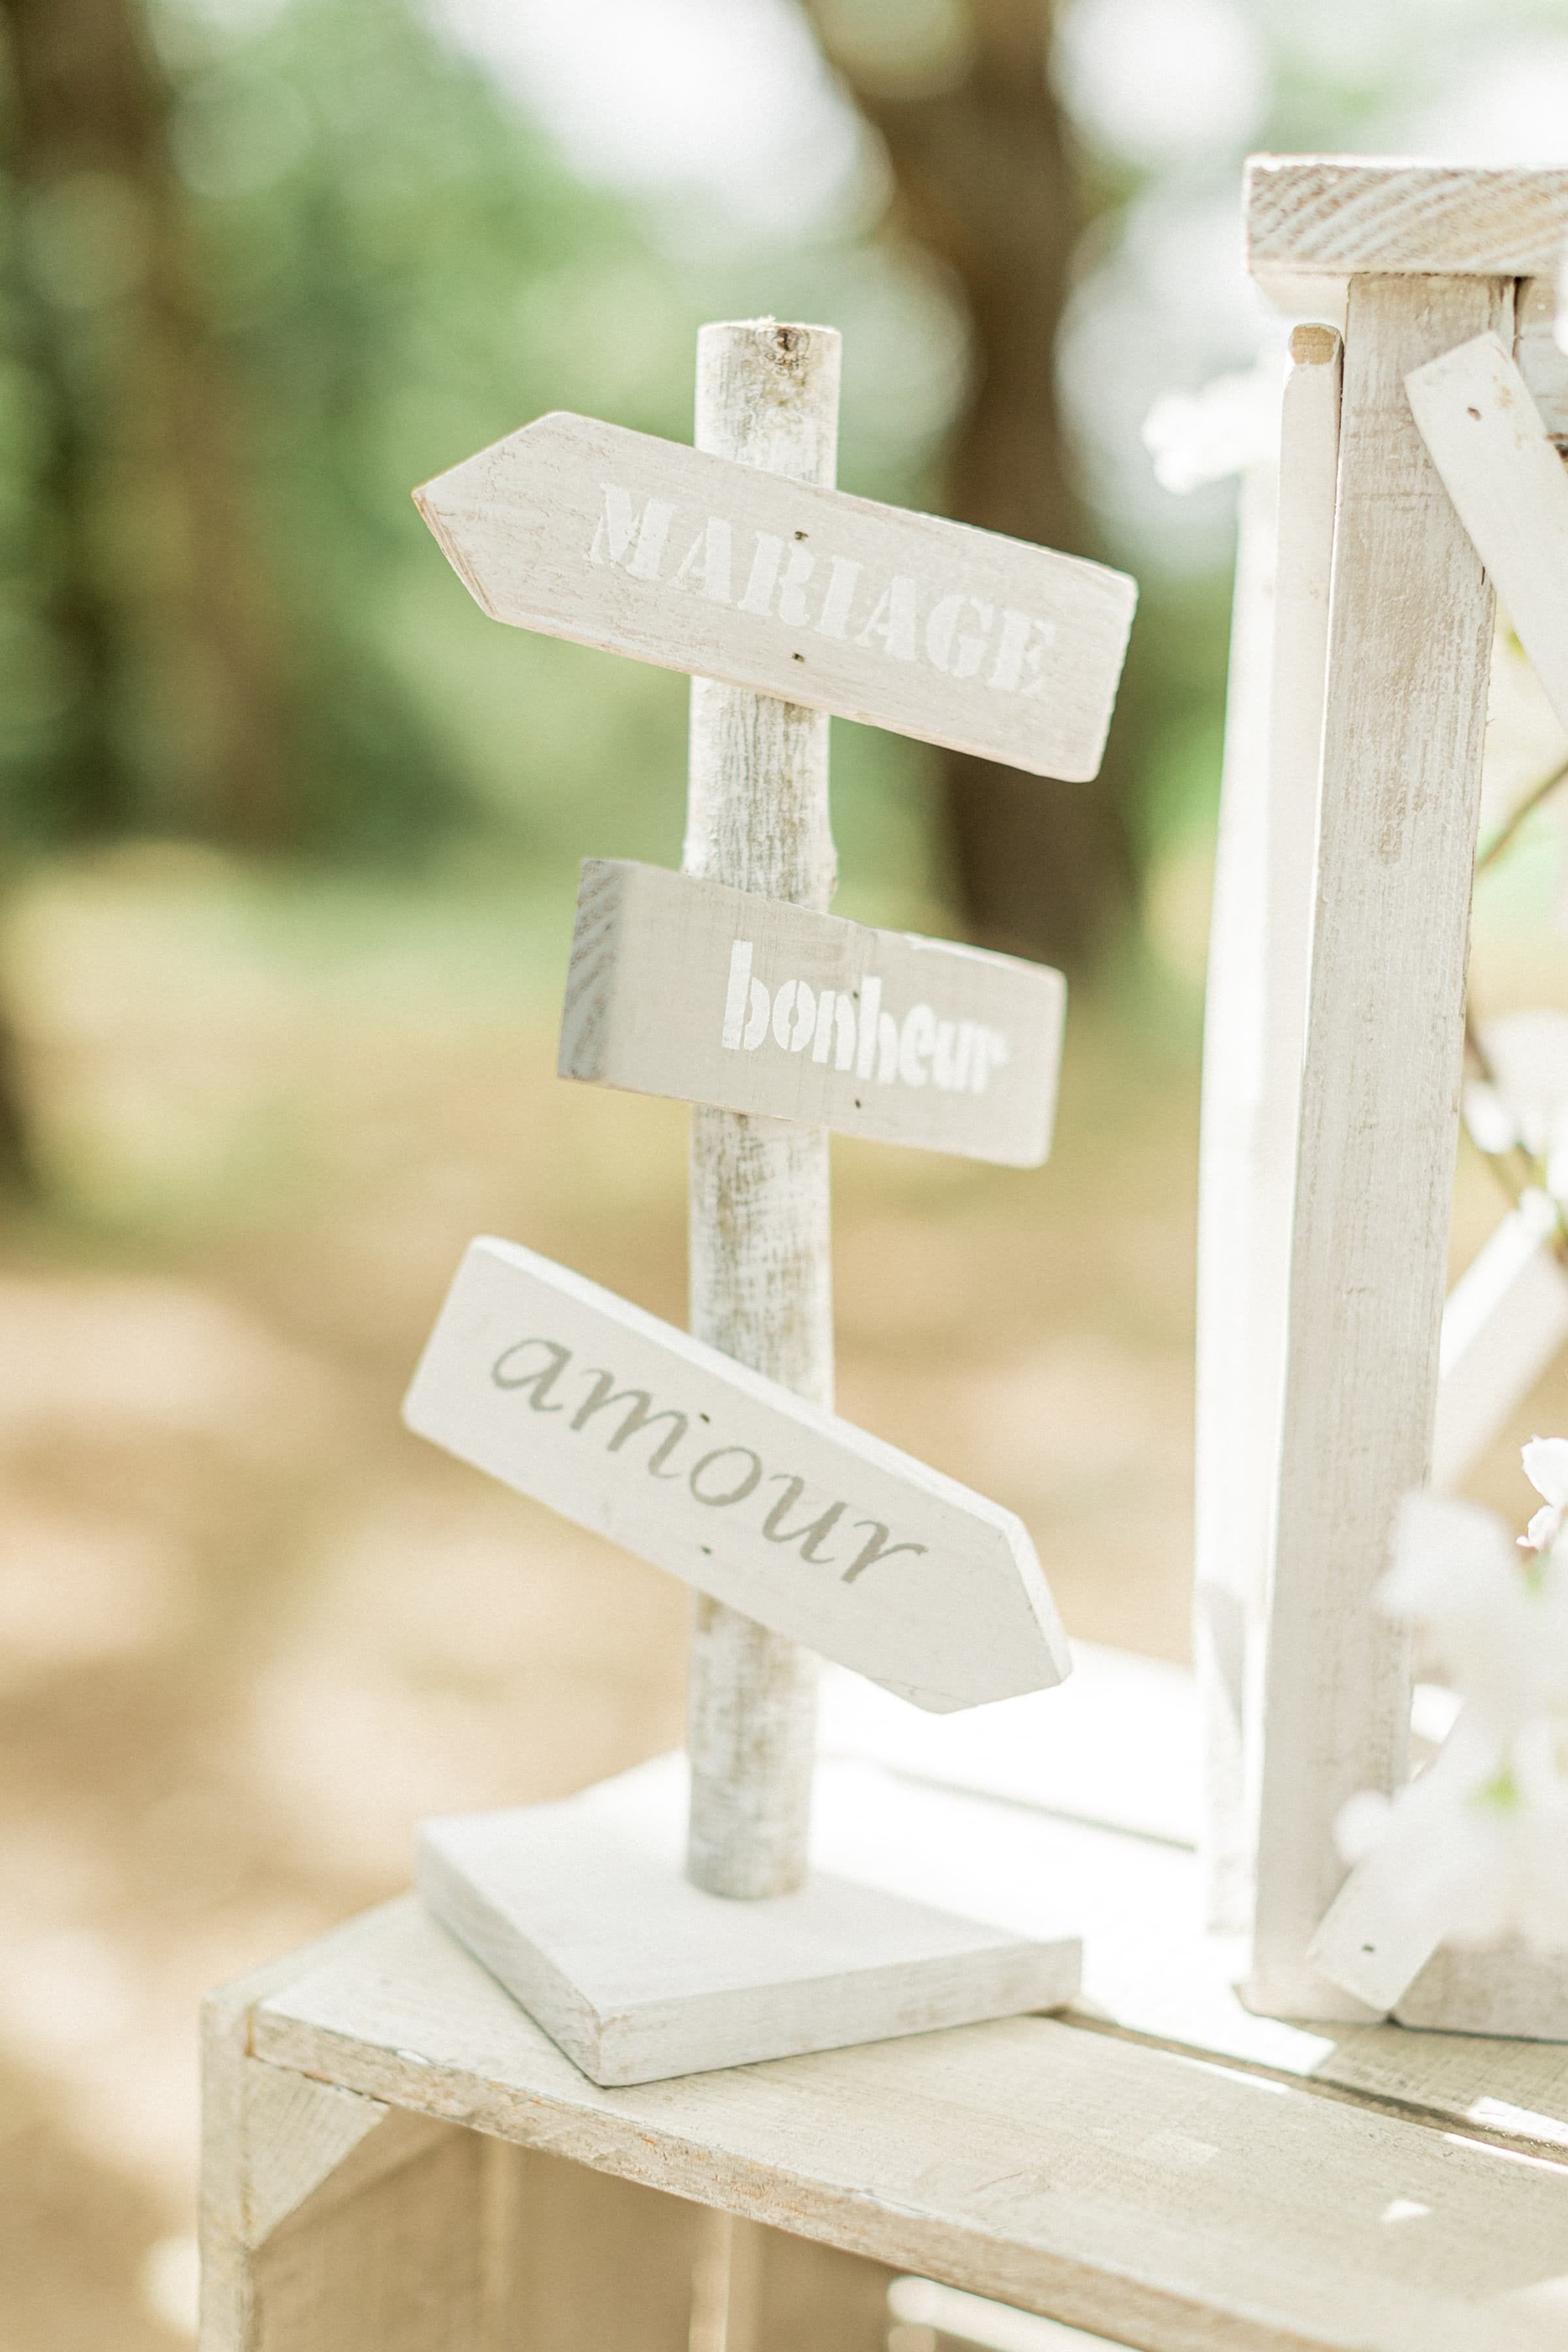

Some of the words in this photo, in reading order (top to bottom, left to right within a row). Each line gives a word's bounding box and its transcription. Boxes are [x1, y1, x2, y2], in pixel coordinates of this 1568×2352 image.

[583, 482, 1056, 696] MARIAGE
[721, 939, 1008, 1094] bonheur
[490, 1337, 928, 1584] amour
